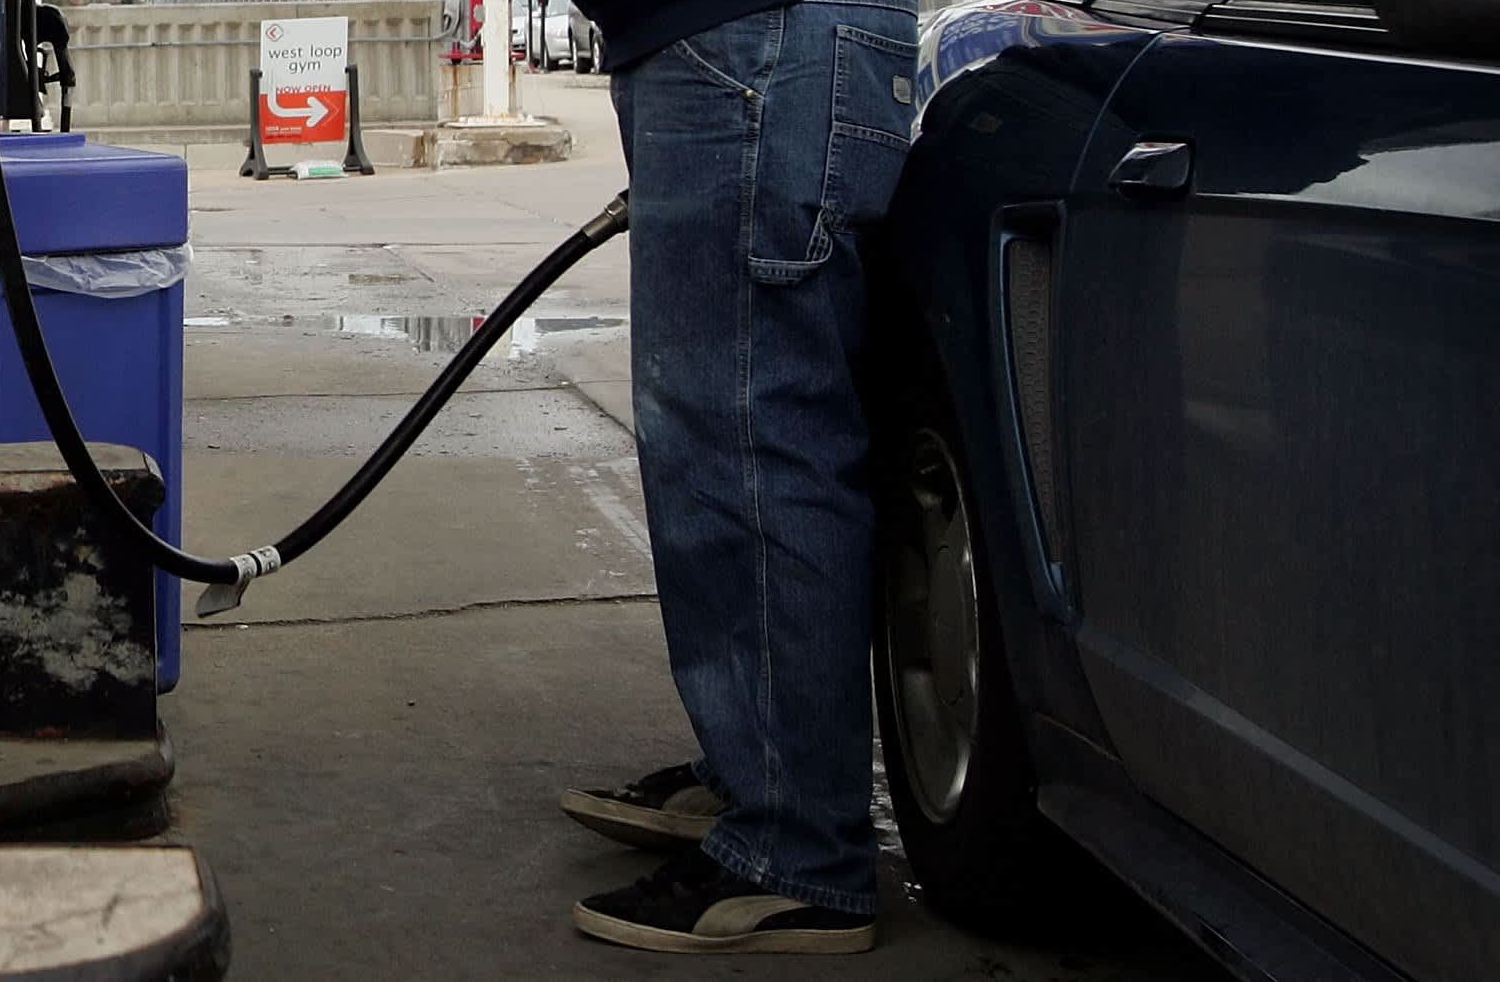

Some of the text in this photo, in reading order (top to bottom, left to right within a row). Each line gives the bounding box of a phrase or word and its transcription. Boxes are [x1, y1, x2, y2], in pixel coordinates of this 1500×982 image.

[268, 44, 342, 59] west loop
[288, 61, 321, 74] gym
[276, 84, 332, 94] NOW OPEN
